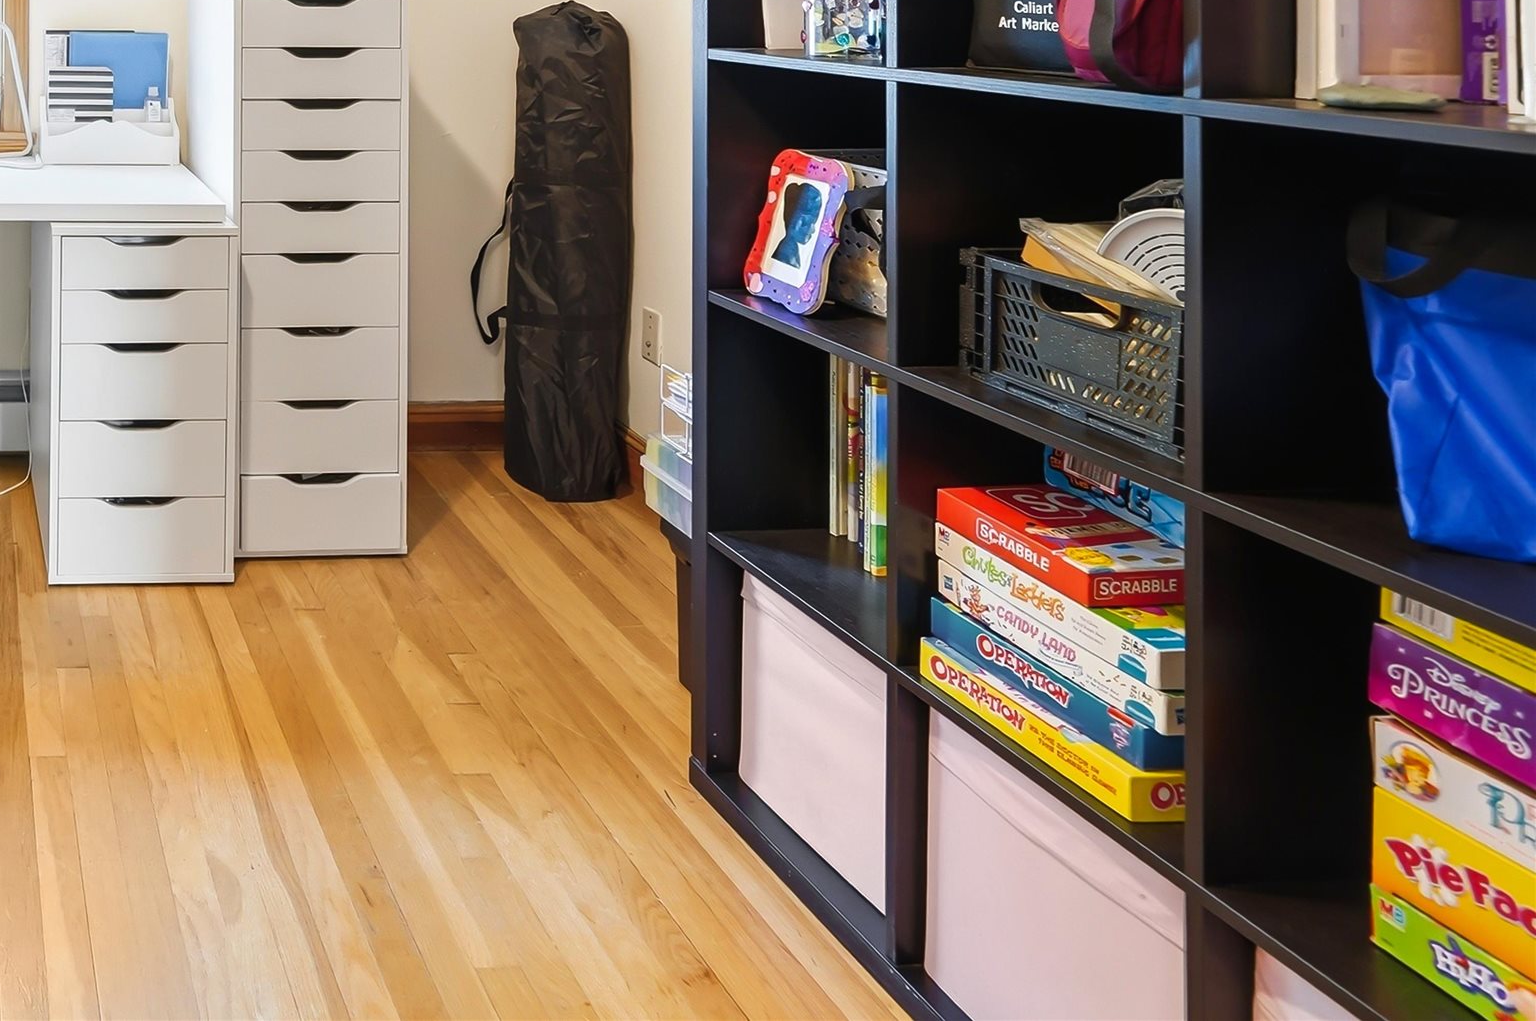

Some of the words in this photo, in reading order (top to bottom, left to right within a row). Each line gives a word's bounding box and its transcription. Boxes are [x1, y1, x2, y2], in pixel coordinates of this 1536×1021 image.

[998, 16, 1017, 29] Art
[1013, 0, 1054, 15] Caliart
[979, 522, 1051, 573] SCRABBLE
[962, 545, 1007, 587] Chutes
[1010, 573, 1066, 622] Ladders
[1098, 577, 1178, 595] SCRABBLE
[996, 605, 1040, 639] CANDY
[1040, 631, 1077, 663] LAND
[929, 654, 1027, 732] OPERATION
[977, 634, 1072, 708] OPERATION
[1387, 663, 1533, 760] PRINCESS
[1385, 838, 1464, 894] Pie
